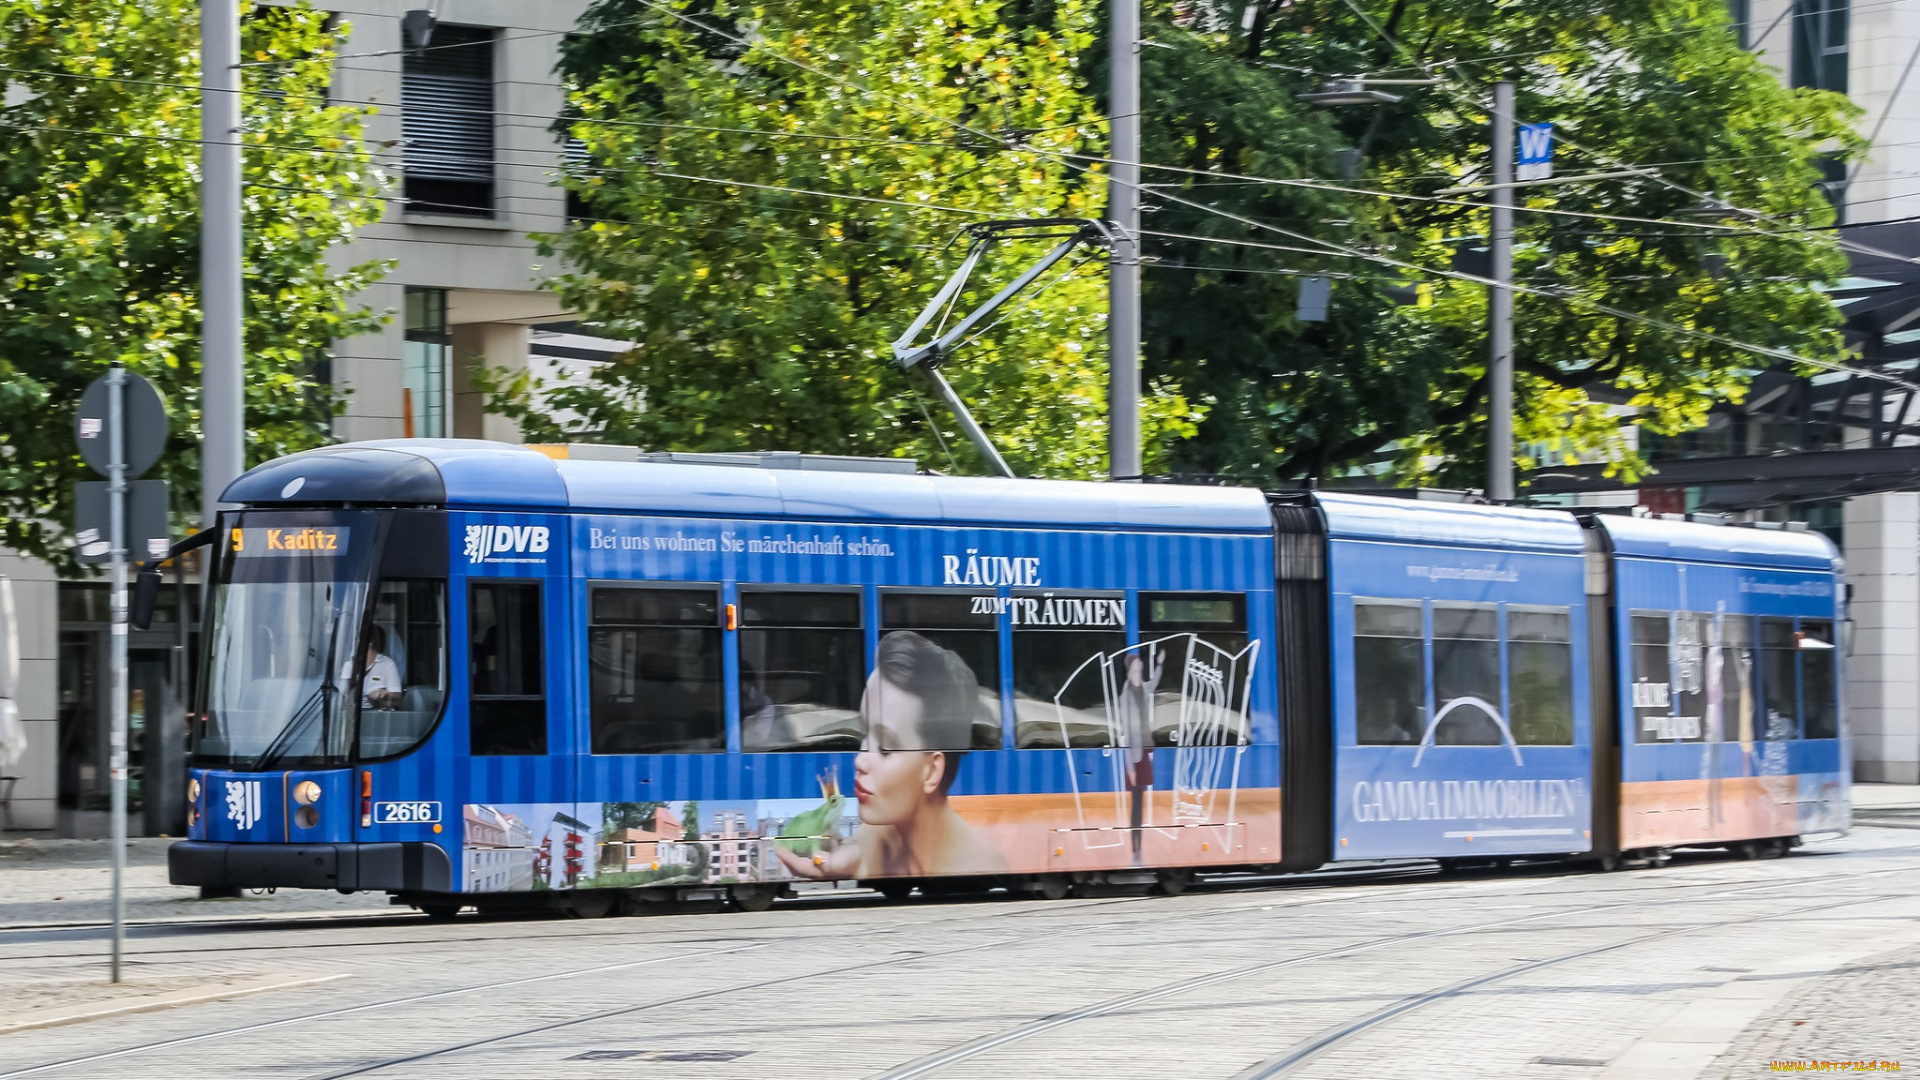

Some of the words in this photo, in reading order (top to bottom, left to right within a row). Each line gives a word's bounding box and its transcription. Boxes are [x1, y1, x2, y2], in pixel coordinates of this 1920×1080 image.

[1520, 127, 1553, 159] W
[231, 528, 244, 551] 9
[267, 529, 338, 550] Kaditz
[493, 525, 550, 552] DVB
[589, 527, 617, 549] Bei
[621, 536, 651, 550] uns
[653, 531, 717, 551] wohnen
[720, 531, 745, 552] Sie
[748, 533, 845, 555] märchenhaft
[847, 536, 895, 556] schön.
[943, 548, 1042, 587] RÄUME
[971, 596, 1007, 614] ZUM
[1006, 592, 1127, 626] TRÄUMEN
[385, 803, 431, 821] 2616
